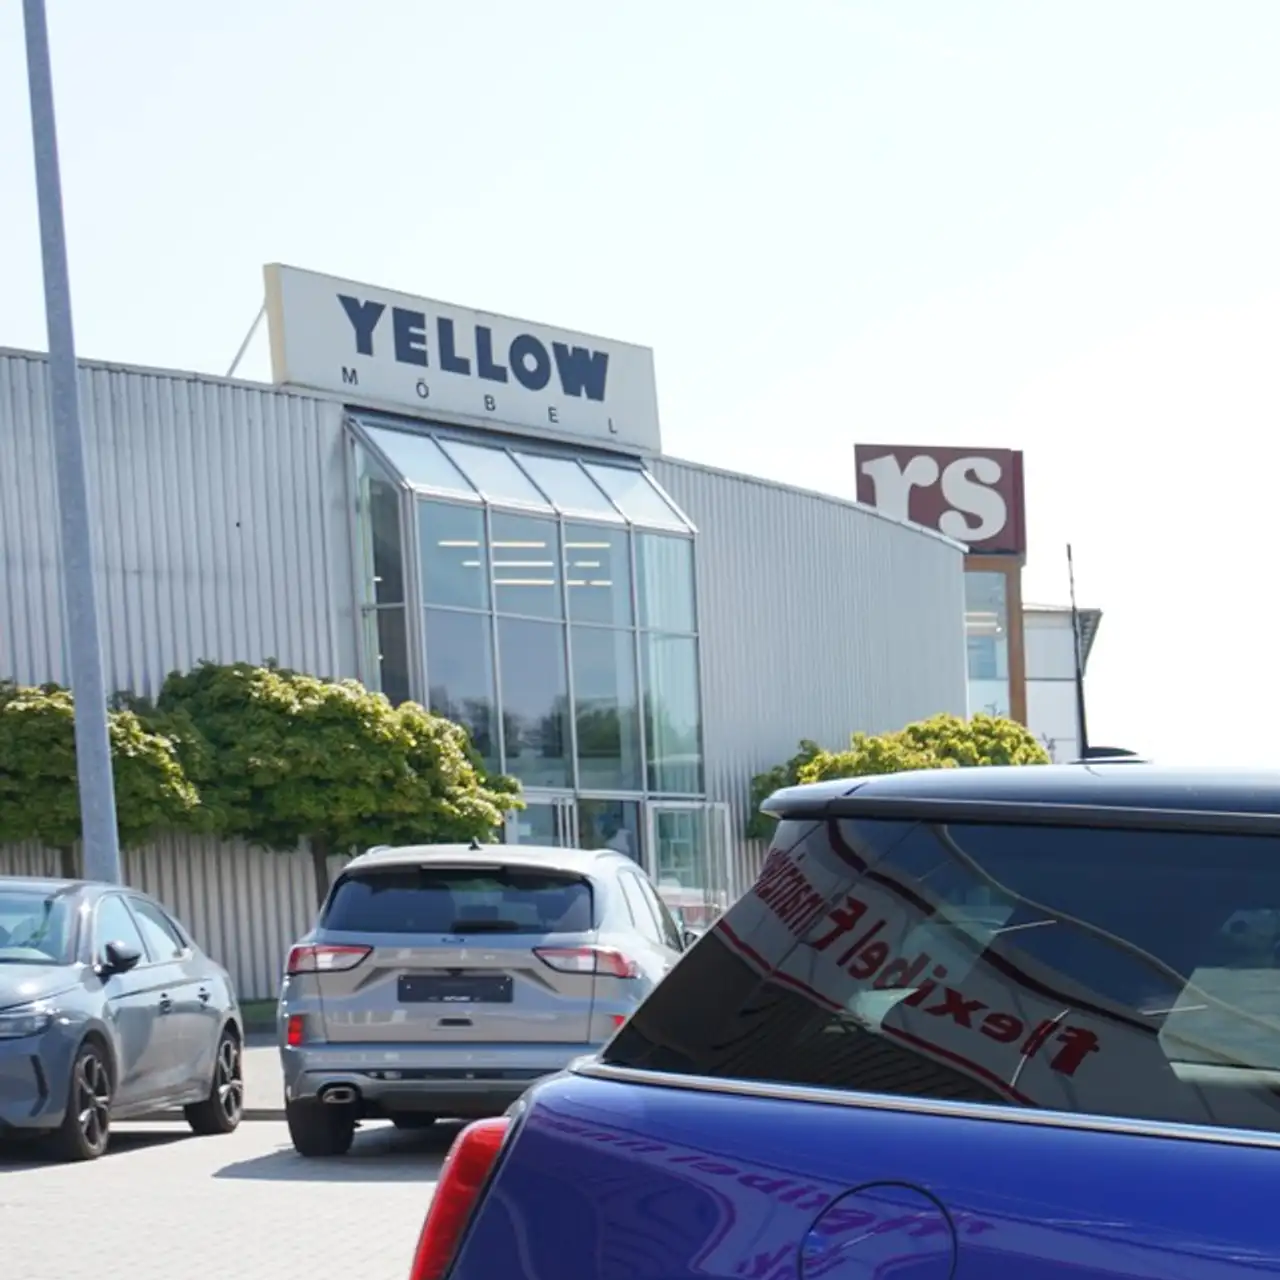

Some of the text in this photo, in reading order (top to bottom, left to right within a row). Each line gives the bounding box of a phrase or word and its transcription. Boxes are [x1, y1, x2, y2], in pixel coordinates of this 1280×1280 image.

[336, 294, 609, 402] YELLOW
[341, 366, 619, 435] MÖBEL
[861, 453, 1007, 541] rs
